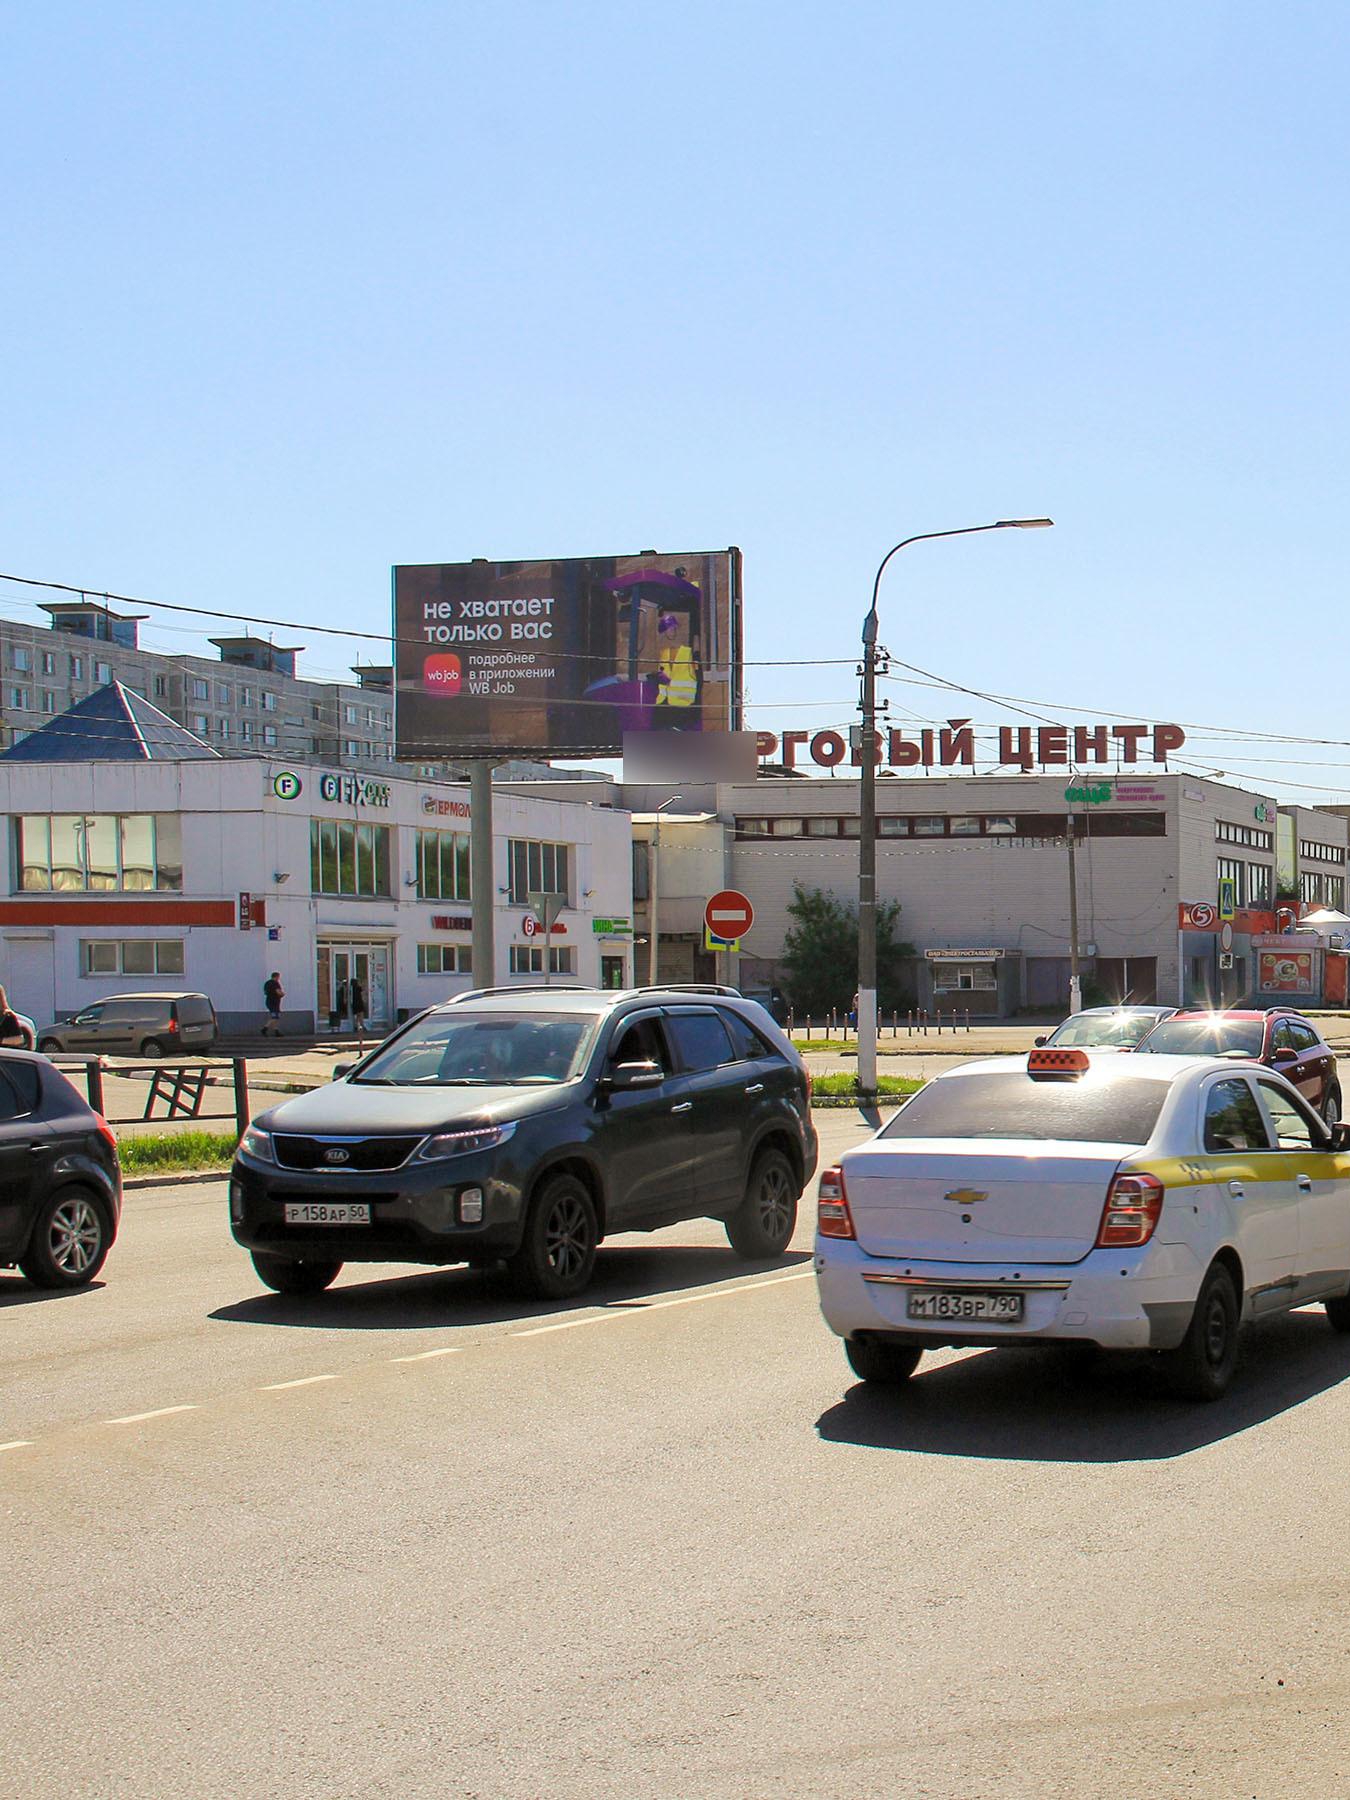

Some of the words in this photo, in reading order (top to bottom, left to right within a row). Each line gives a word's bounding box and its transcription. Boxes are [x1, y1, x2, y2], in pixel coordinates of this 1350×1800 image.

[424, 602, 452, 619] не
[459, 598, 555, 618] хватает
[424, 623, 503, 643] только
[511, 621, 553, 640] вас
[469, 652, 536, 667] подробнее
[469, 671, 477, 680] в
[479, 667, 555, 681] приложении
[469, 682, 490, 694] WB
[493, 681, 515, 694] Job
[999, 725, 1186, 772] ЦЕНТР
[1065, 782, 1112, 805] ещё
[327, 1151, 345, 1160] KIA
[989, 1296, 1018, 1312] 790
